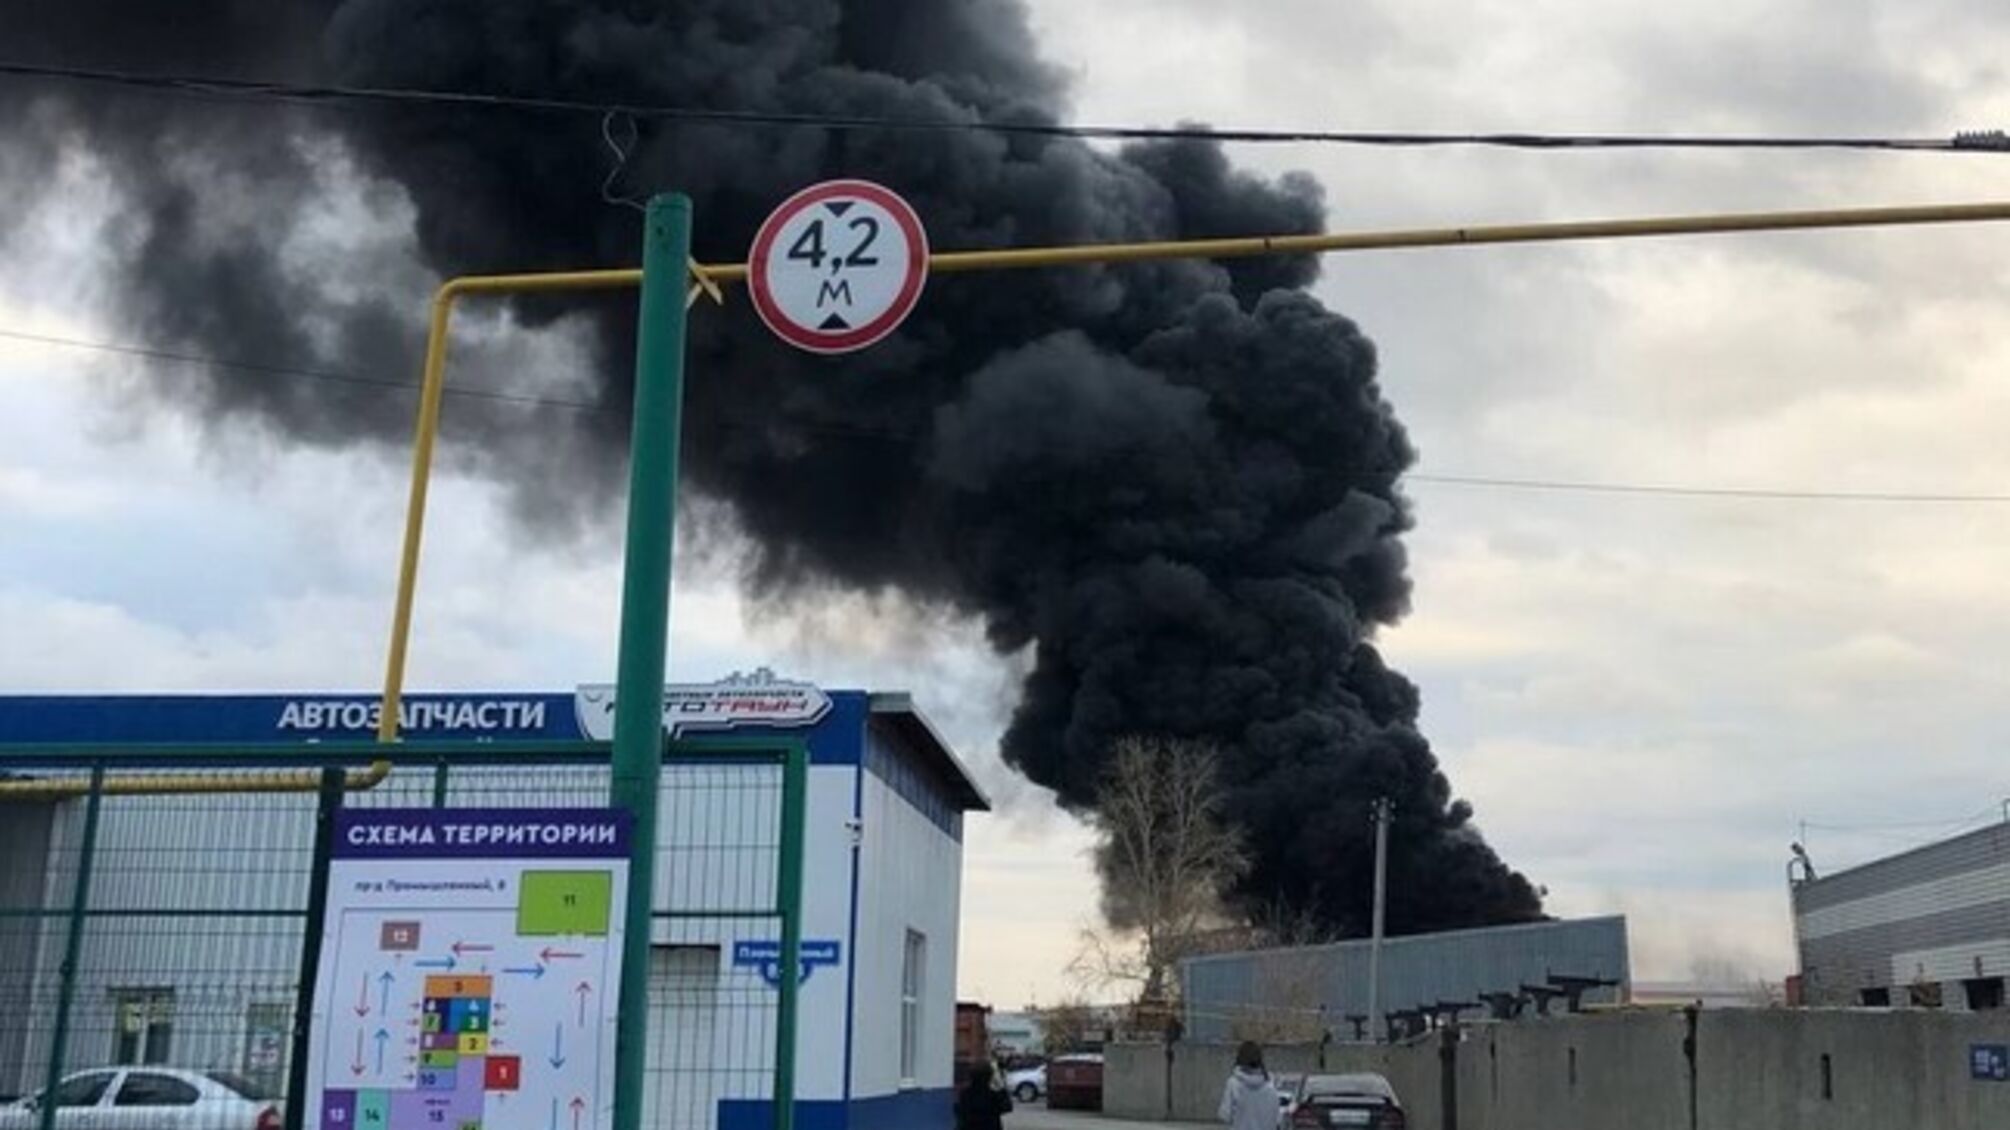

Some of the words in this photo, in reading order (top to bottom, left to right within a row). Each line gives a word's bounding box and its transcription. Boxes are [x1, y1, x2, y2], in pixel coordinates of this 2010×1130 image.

[787, 216, 880, 276] 4,2
[816, 279, 852, 309] М
[605, 699, 809, 713] ТОТАУН
[347, 825, 435, 845] СХЕМА
[443, 824, 616, 844] ТЕРРИТОРИИ
[564, 894, 576, 906] 11
[469, 1037, 478, 1050] 2
[364, 1108, 380, 1122] 14
